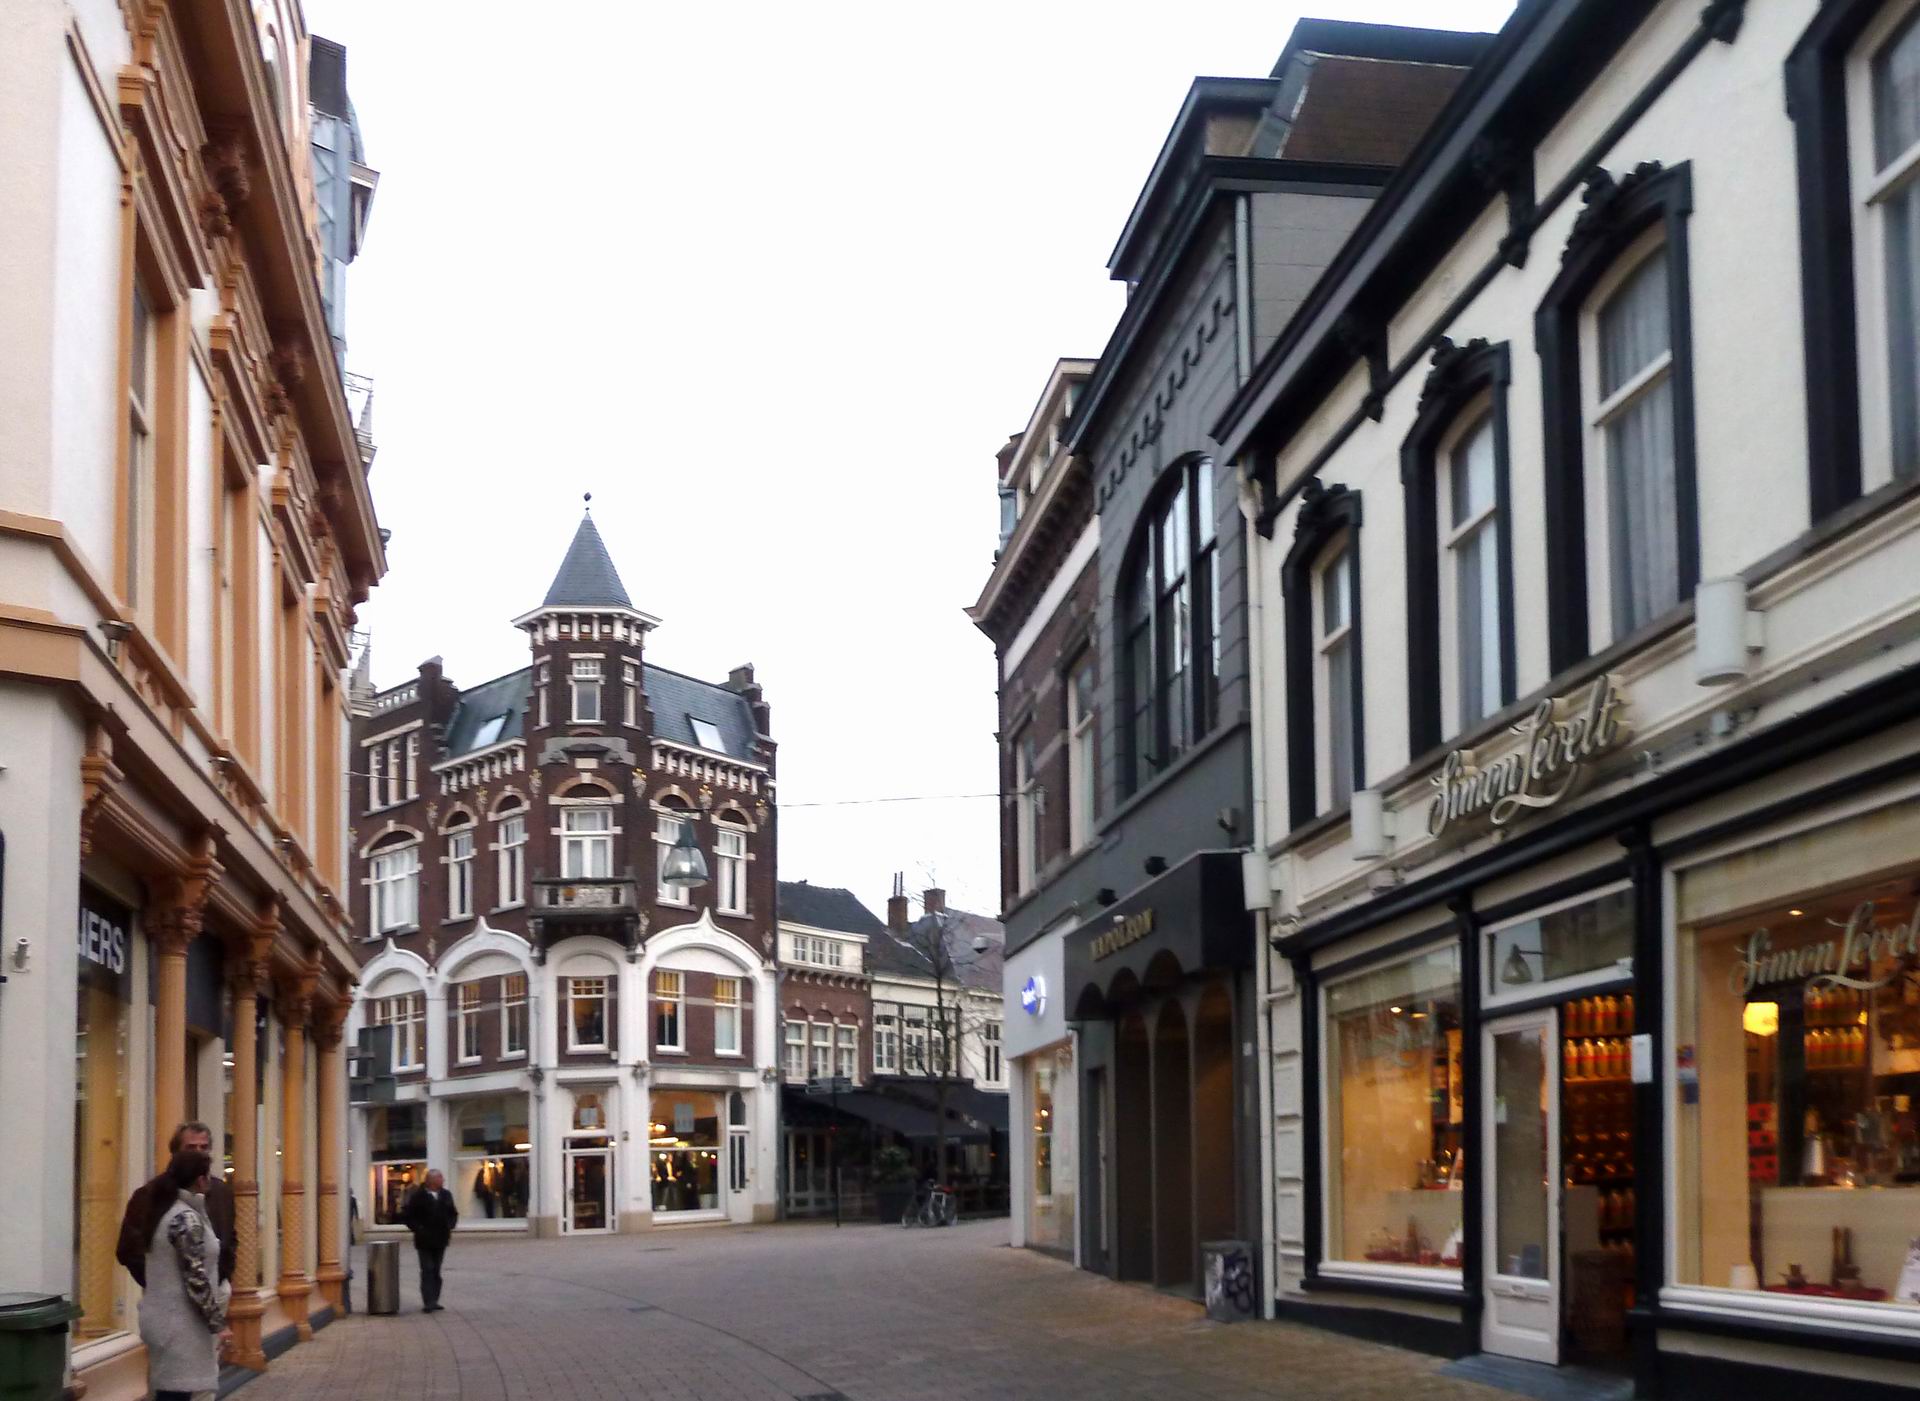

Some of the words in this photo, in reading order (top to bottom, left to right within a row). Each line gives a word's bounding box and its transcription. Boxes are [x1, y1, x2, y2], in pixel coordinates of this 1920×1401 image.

[1427, 750, 1522, 840] Simon
[1490, 675, 1618, 825] Levelt
[79, 907, 125, 974] IERS
[1729, 927, 1836, 999] Simon
